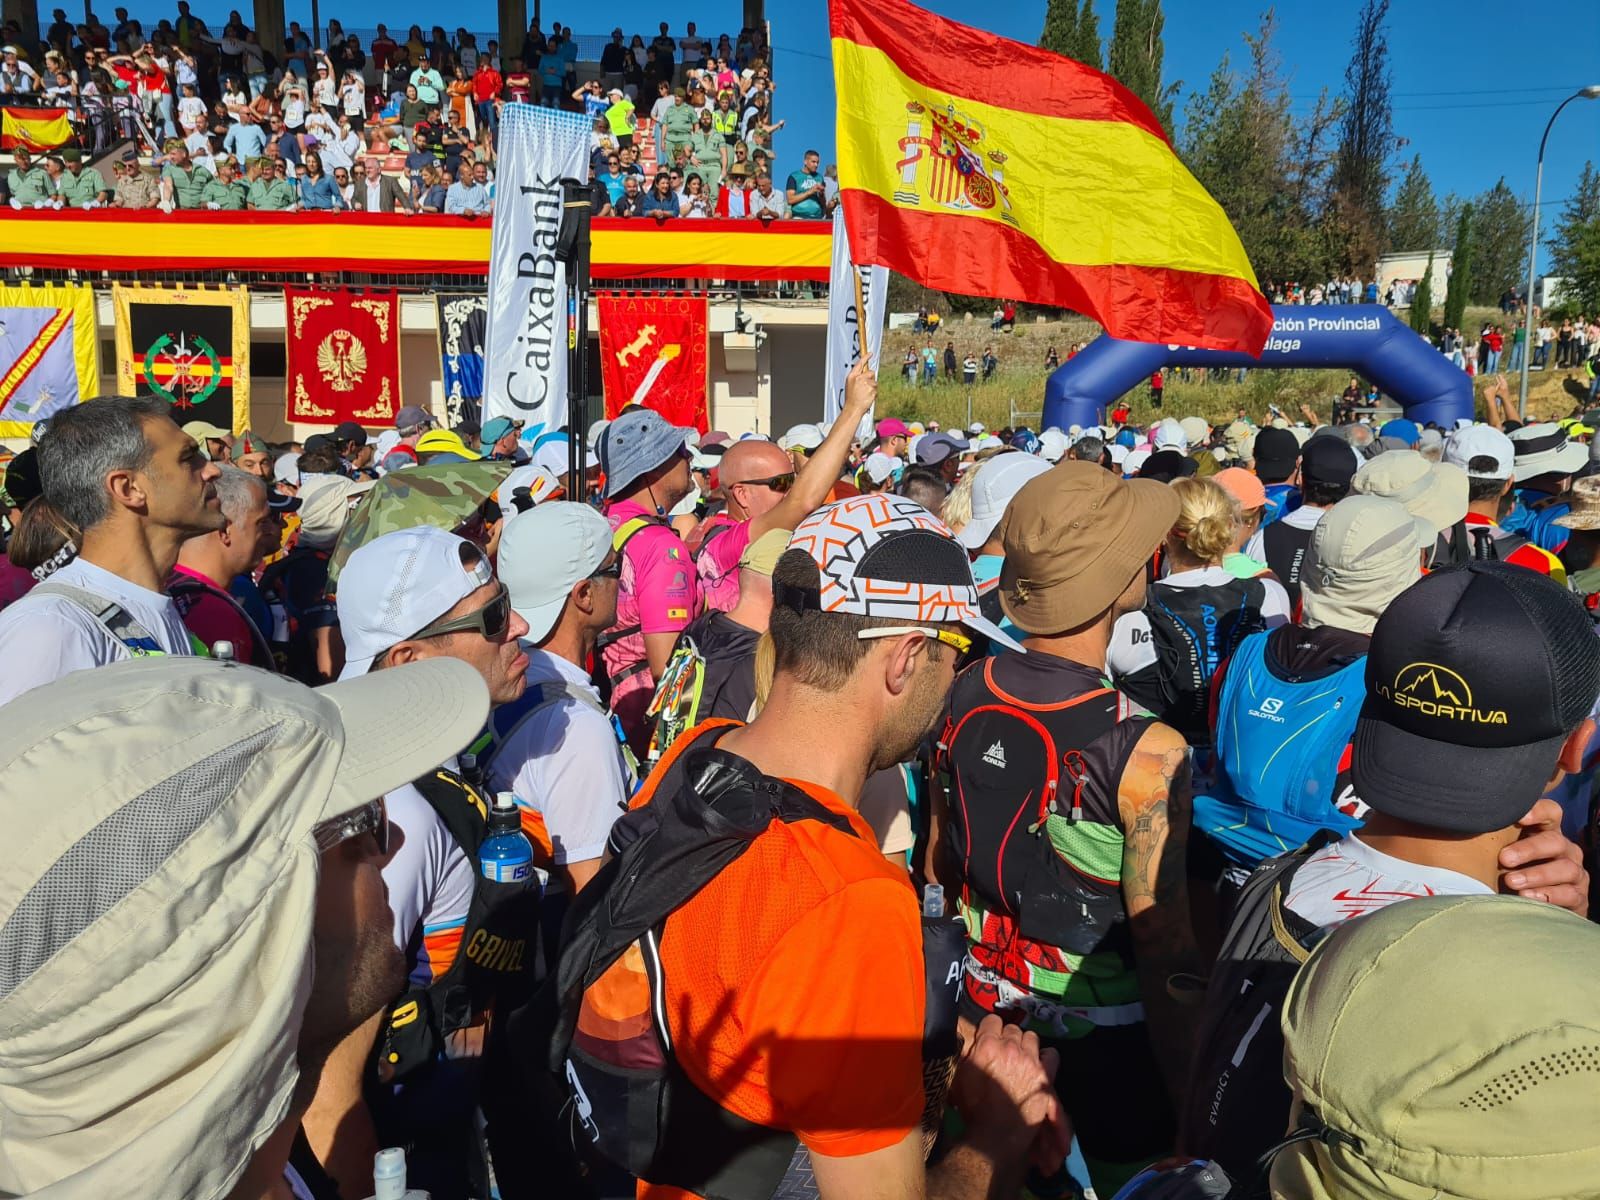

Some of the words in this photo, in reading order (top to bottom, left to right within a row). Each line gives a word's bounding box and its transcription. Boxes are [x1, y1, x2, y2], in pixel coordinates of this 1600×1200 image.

[507, 173, 561, 411] CaixaBank
[611, 300, 690, 313] TANTO
[1271, 317, 1305, 332] ción
[1308, 317, 1380, 331] Provincial
[1289, 548, 1305, 584] KIPRUN
[1376, 681, 1391, 700] LA
[1394, 692, 1508, 724] SPORTIVA
[466, 928, 526, 972] GRIVEL
[1209, 1070, 1230, 1126] EVADICT
